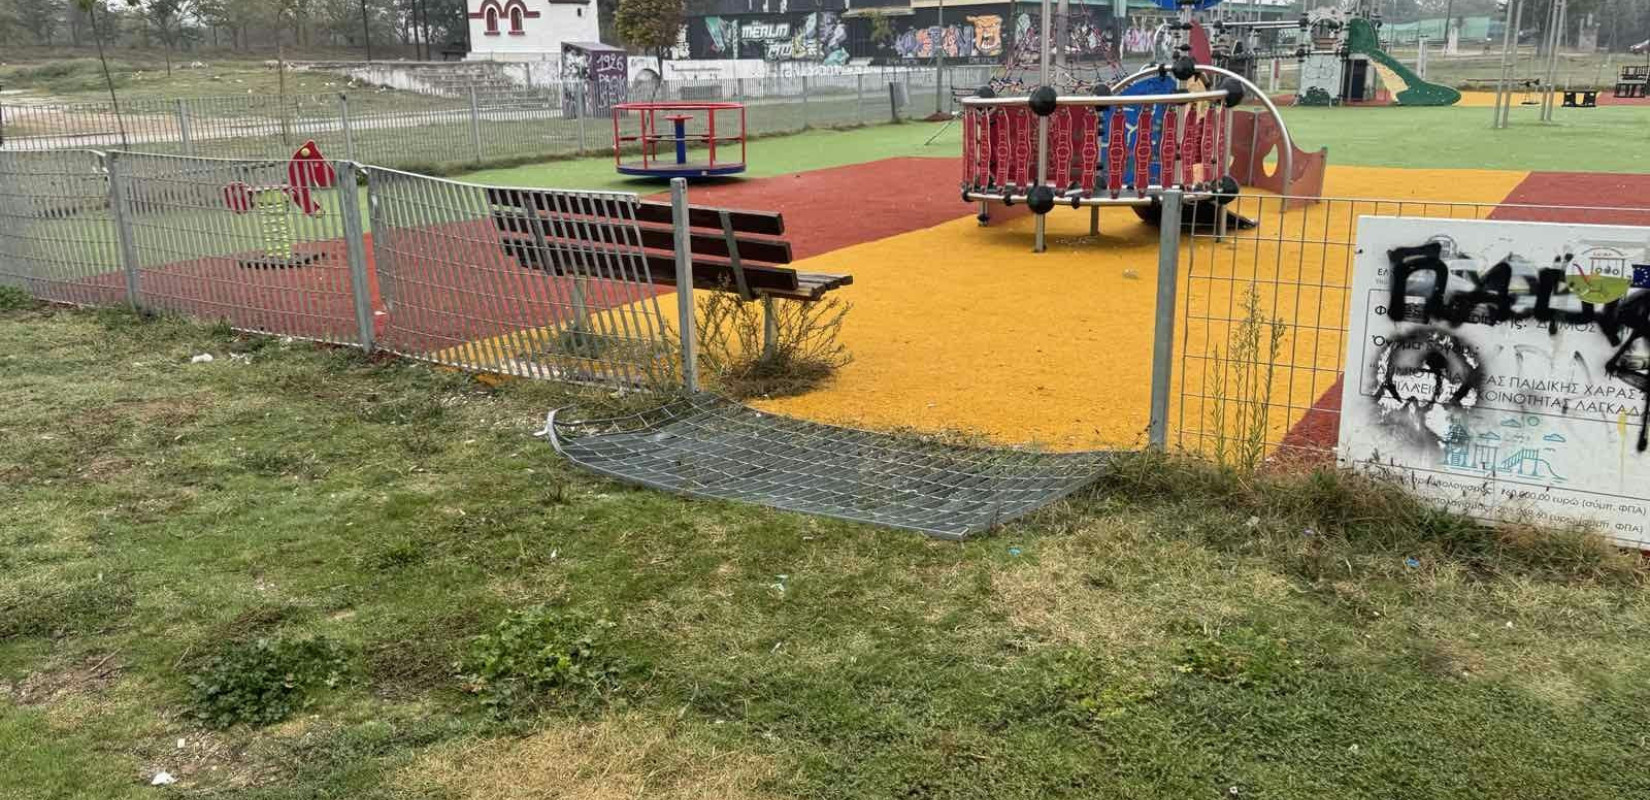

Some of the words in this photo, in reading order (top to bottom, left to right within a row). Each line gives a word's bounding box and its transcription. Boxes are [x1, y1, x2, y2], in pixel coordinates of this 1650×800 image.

[596, 52, 625, 72] 1926
[1509, 376, 1579, 395] ΠΑΙΔΙΚΗΣ
[1583, 384, 1637, 401] ΧΑΡΑΣ
[1575, 400, 1645, 417] ΛΑΓΚΑΔ
[1618, 504, 1647, 516] ΦΠΑ)
[1615, 521, 1644, 535] ΦΠΑ)
